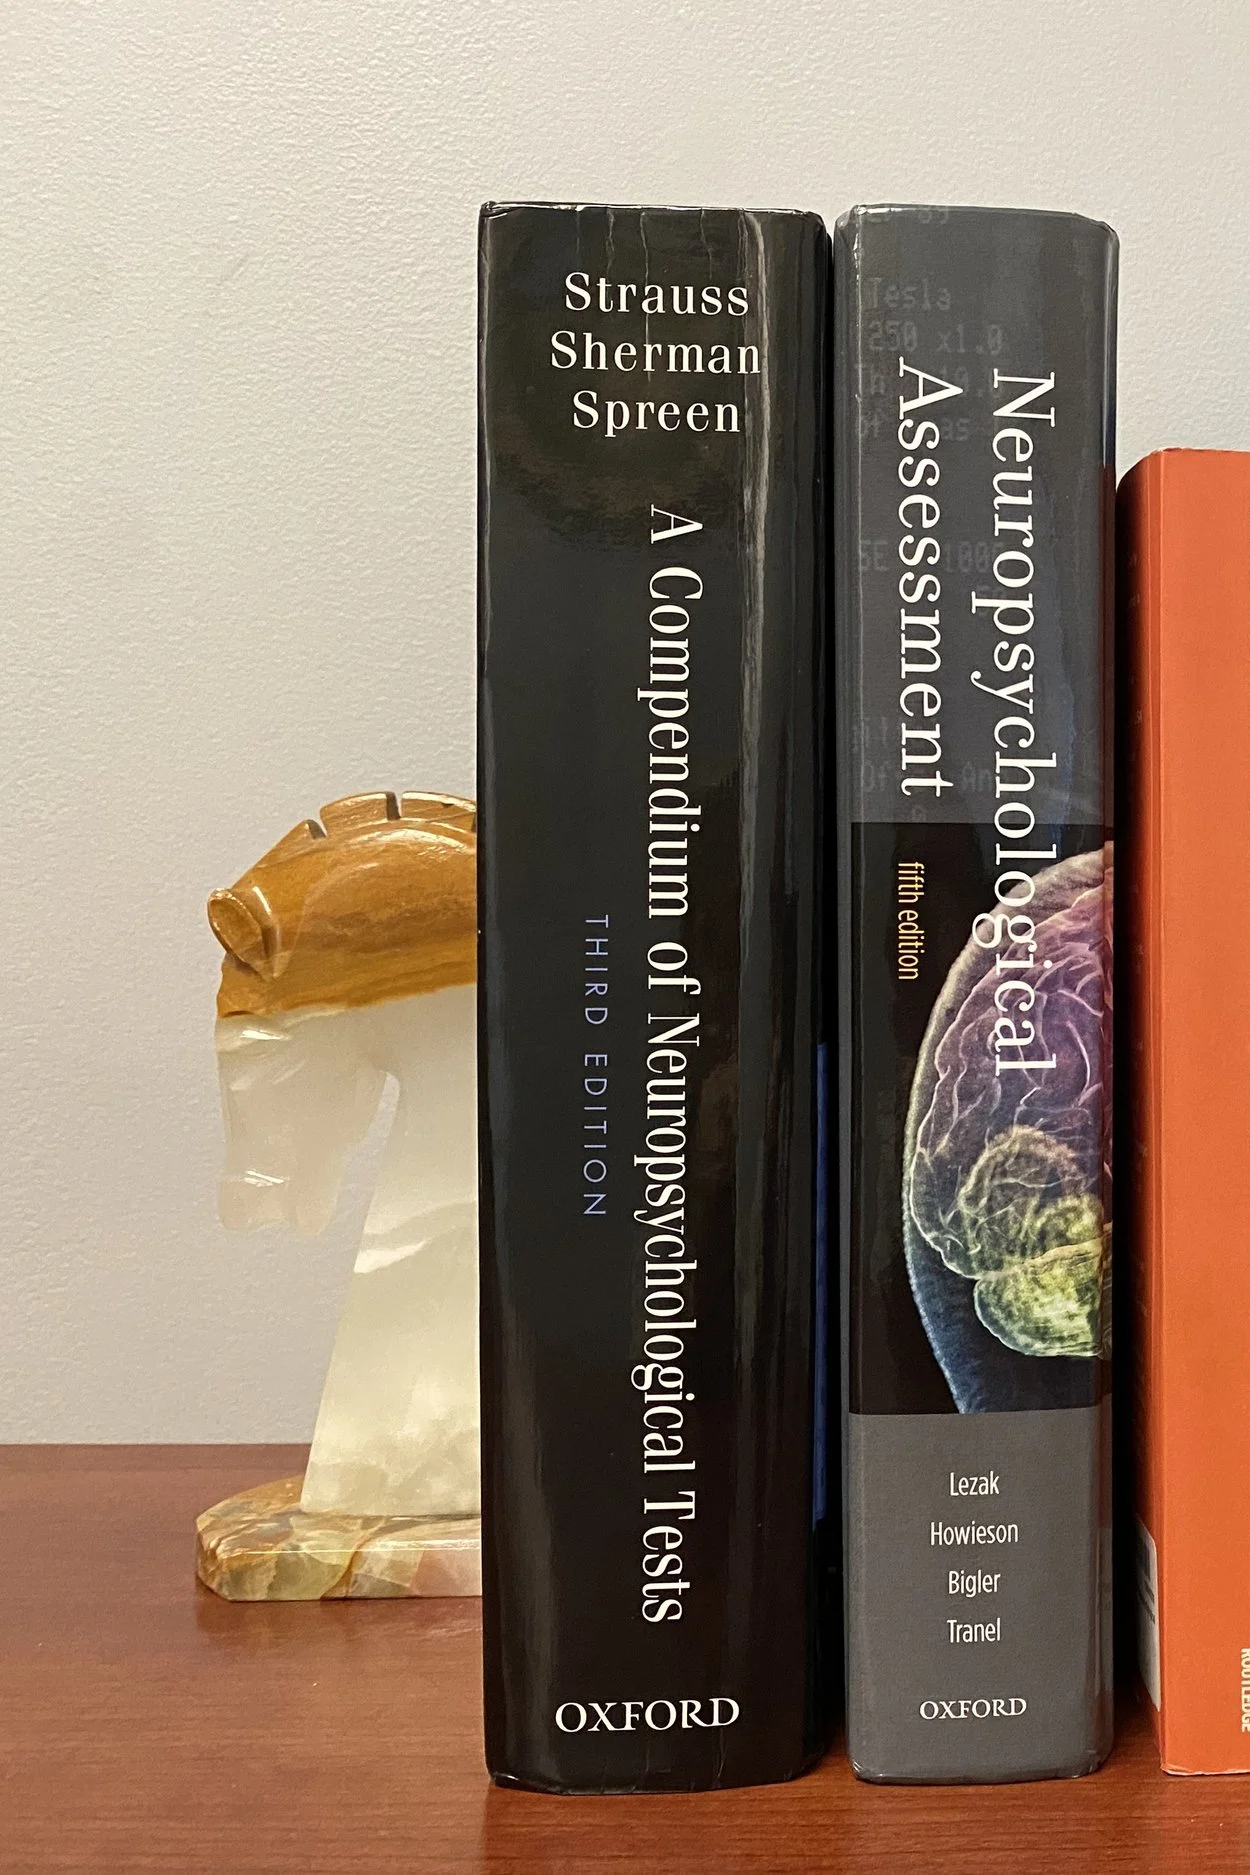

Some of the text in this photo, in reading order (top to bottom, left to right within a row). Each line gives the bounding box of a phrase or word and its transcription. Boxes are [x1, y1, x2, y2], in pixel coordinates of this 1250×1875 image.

[565, 271, 749, 316] Strauss
[551, 330, 761, 375] Sherman
[573, 390, 741, 438] Spreen
[897, 355, 964, 797] Assessment
[970, 366, 1058, 1078] Neuropsychological
[897, 861, 925, 980] fifth edition
[583, 914, 609, 1215] THIRD EDITION
[630, 503, 704, 1623] A Compendium of Neuropsychological Tests
[950, 1470, 1000, 1497] Lezak
[930, 1520, 1019, 1546] Howieson
[948, 1569, 1001, 1598] Bigler
[946, 1617, 1001, 1643] Tranel
[555, 1697, 740, 1733] OXFORD
[919, 1697, 1027, 1720] OXFORD
